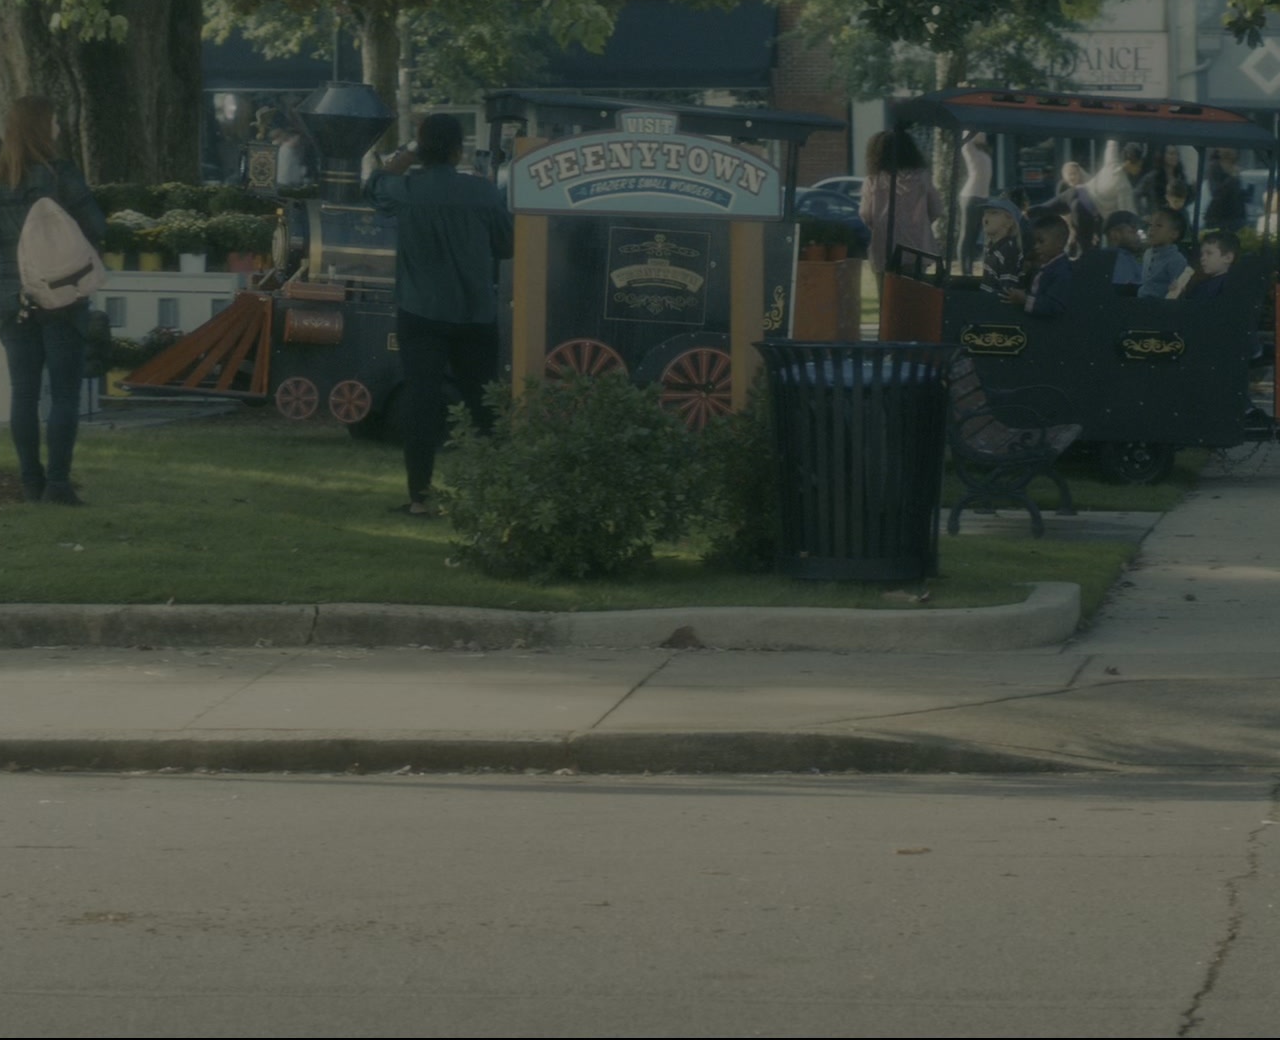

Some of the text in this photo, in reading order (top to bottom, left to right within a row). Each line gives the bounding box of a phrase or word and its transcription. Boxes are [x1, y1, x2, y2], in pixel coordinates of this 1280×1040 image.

[1047, 47, 1153, 79] DANCE
[627, 117, 673, 134] VISIT
[530, 140, 767, 195] TEENYTOWN
